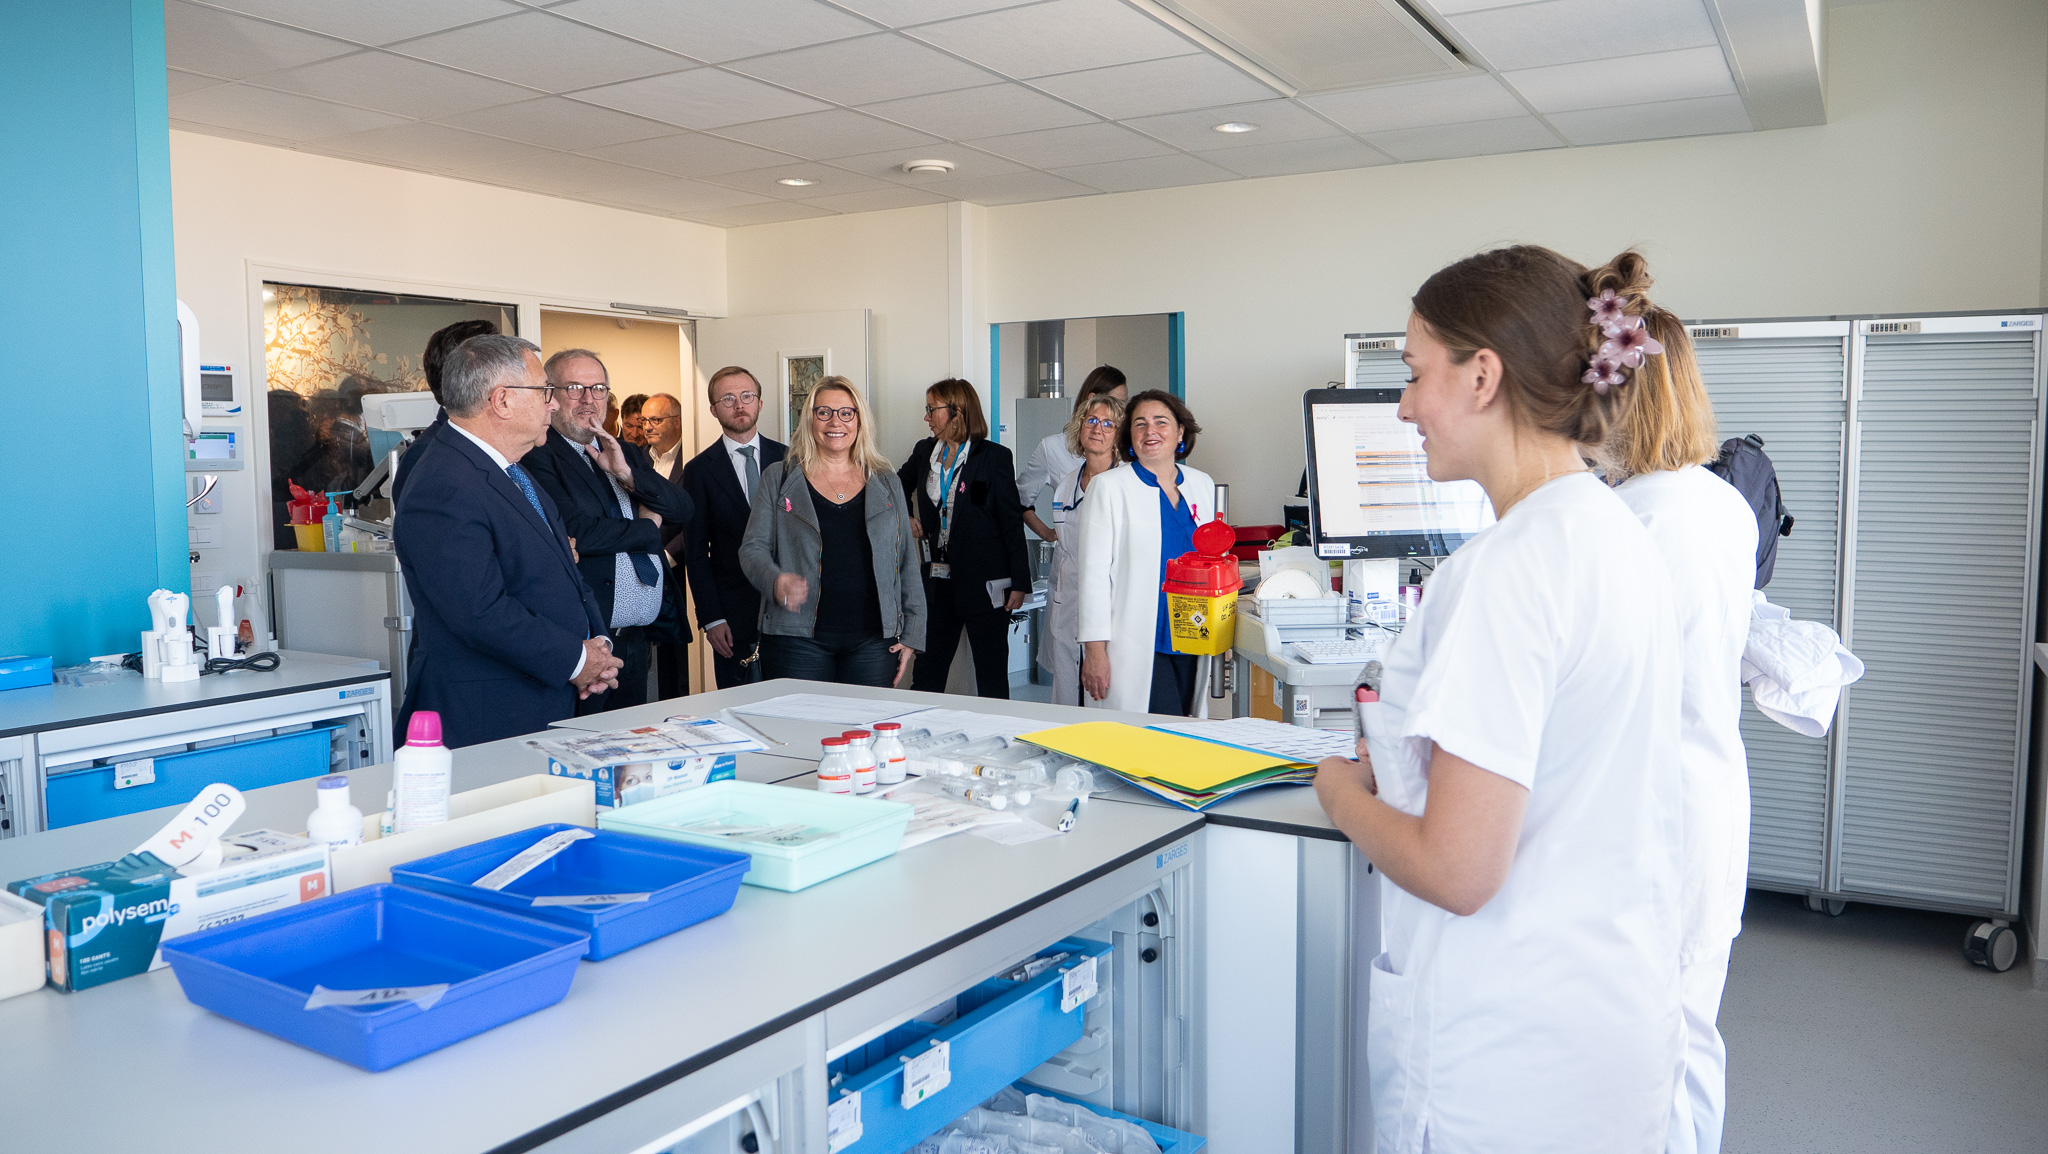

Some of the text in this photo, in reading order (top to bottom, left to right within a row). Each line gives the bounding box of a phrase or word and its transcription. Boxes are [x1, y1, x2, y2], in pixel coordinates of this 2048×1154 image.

[346, 687, 373, 699] ZARGES
[194, 793, 231, 827] 100
[1163, 843, 1188, 865] ZARGES
[307, 879, 318, 892] M
[82, 898, 168, 935] polysem
